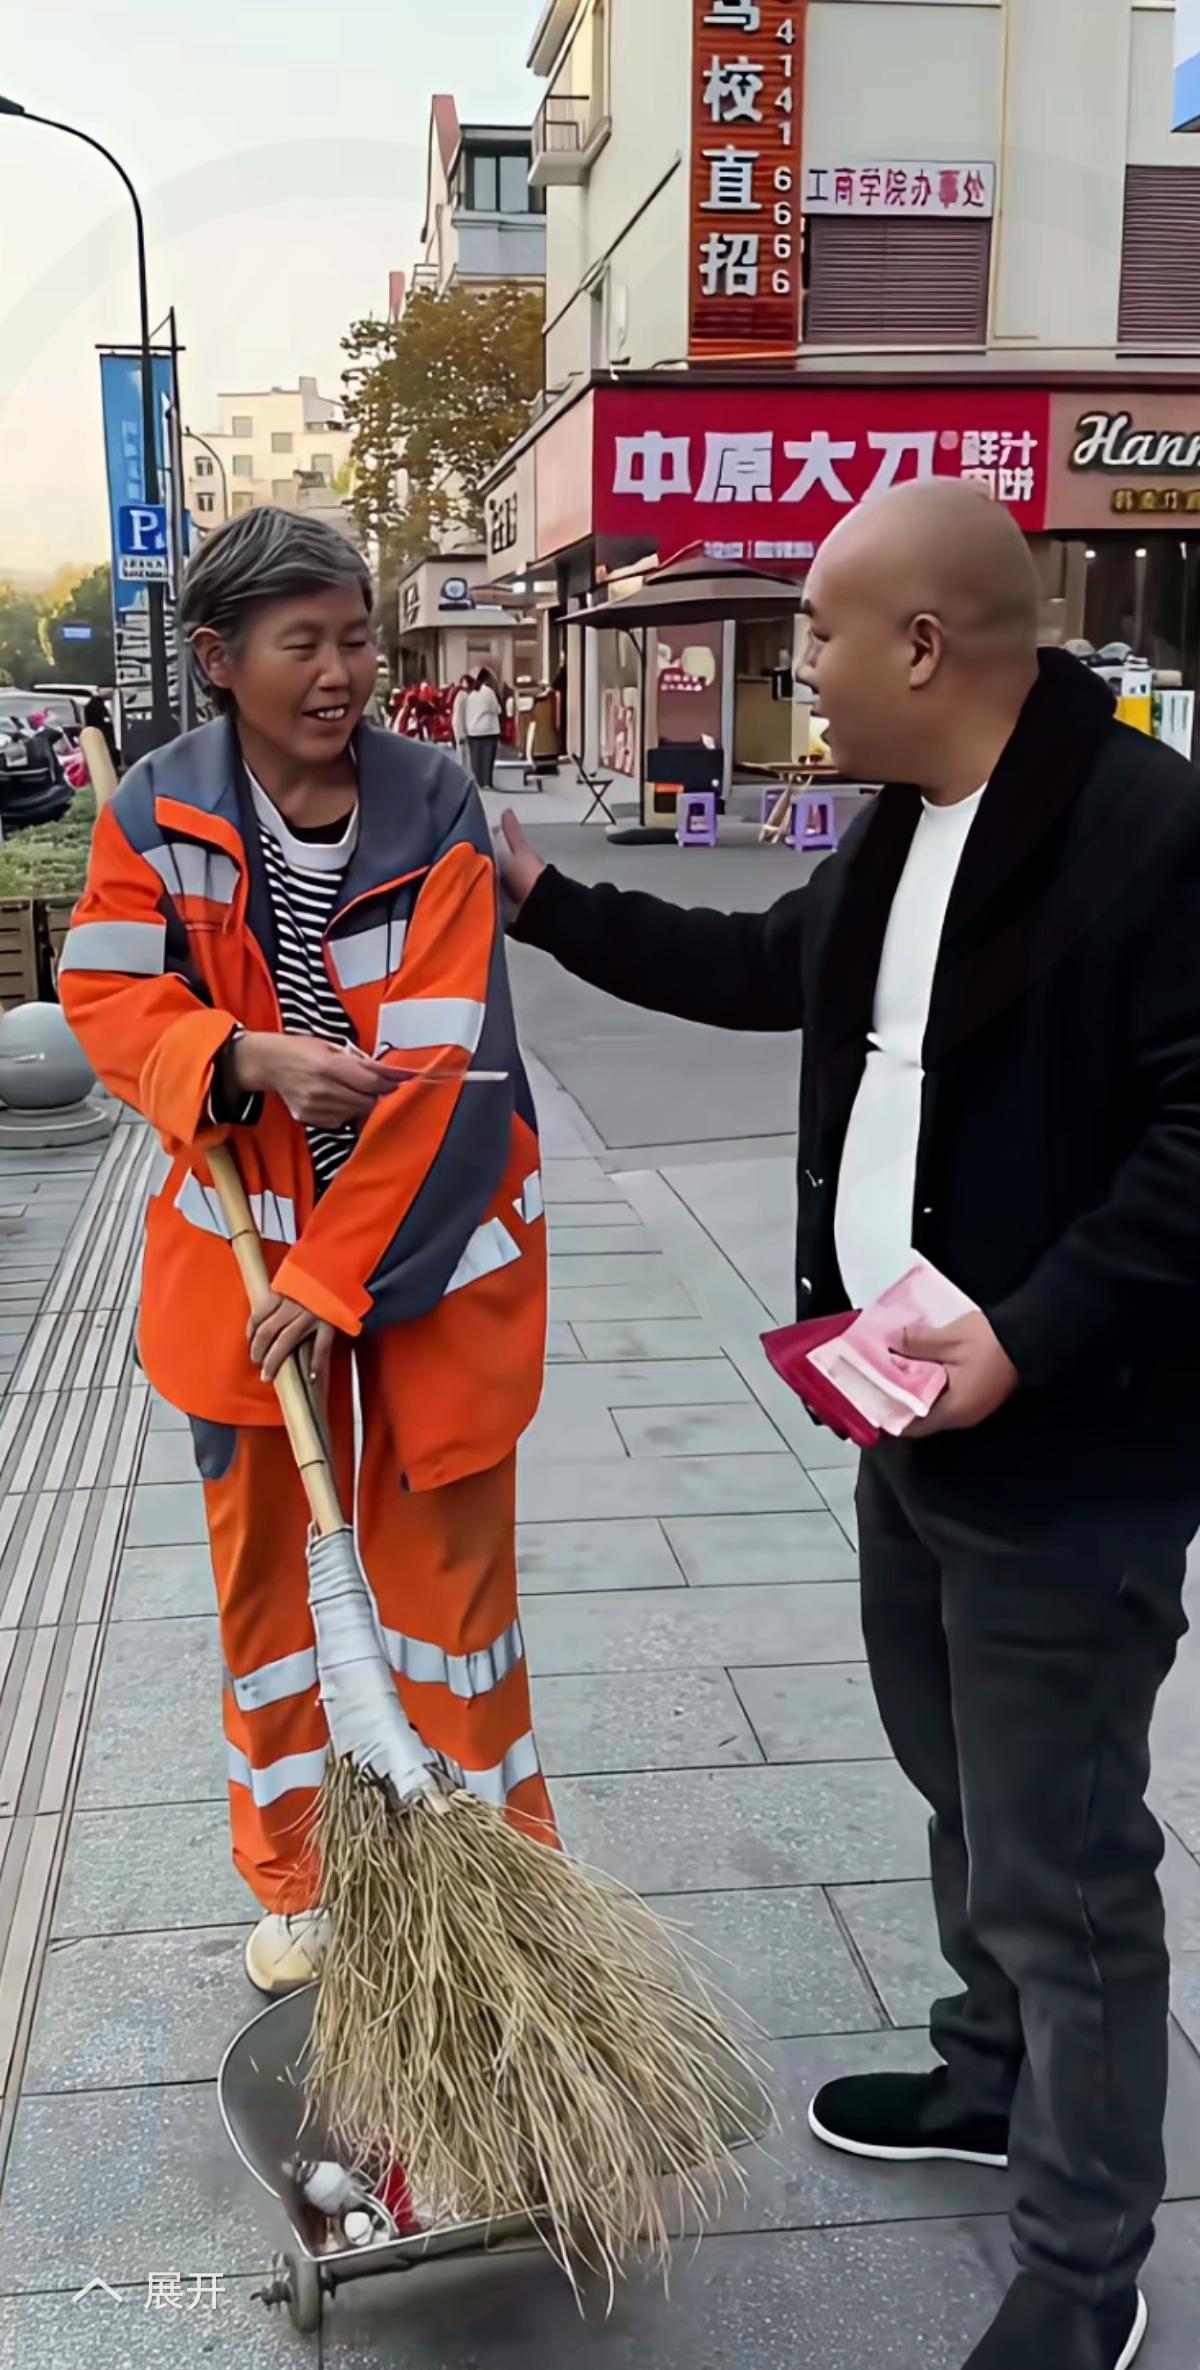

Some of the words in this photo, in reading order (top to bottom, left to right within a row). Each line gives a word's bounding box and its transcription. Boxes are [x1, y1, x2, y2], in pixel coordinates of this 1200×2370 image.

[805, 167, 986, 208] 工商学院办事处
[612, 430, 938, 503] 中原大刀
[129, 509, 158, 551] P
